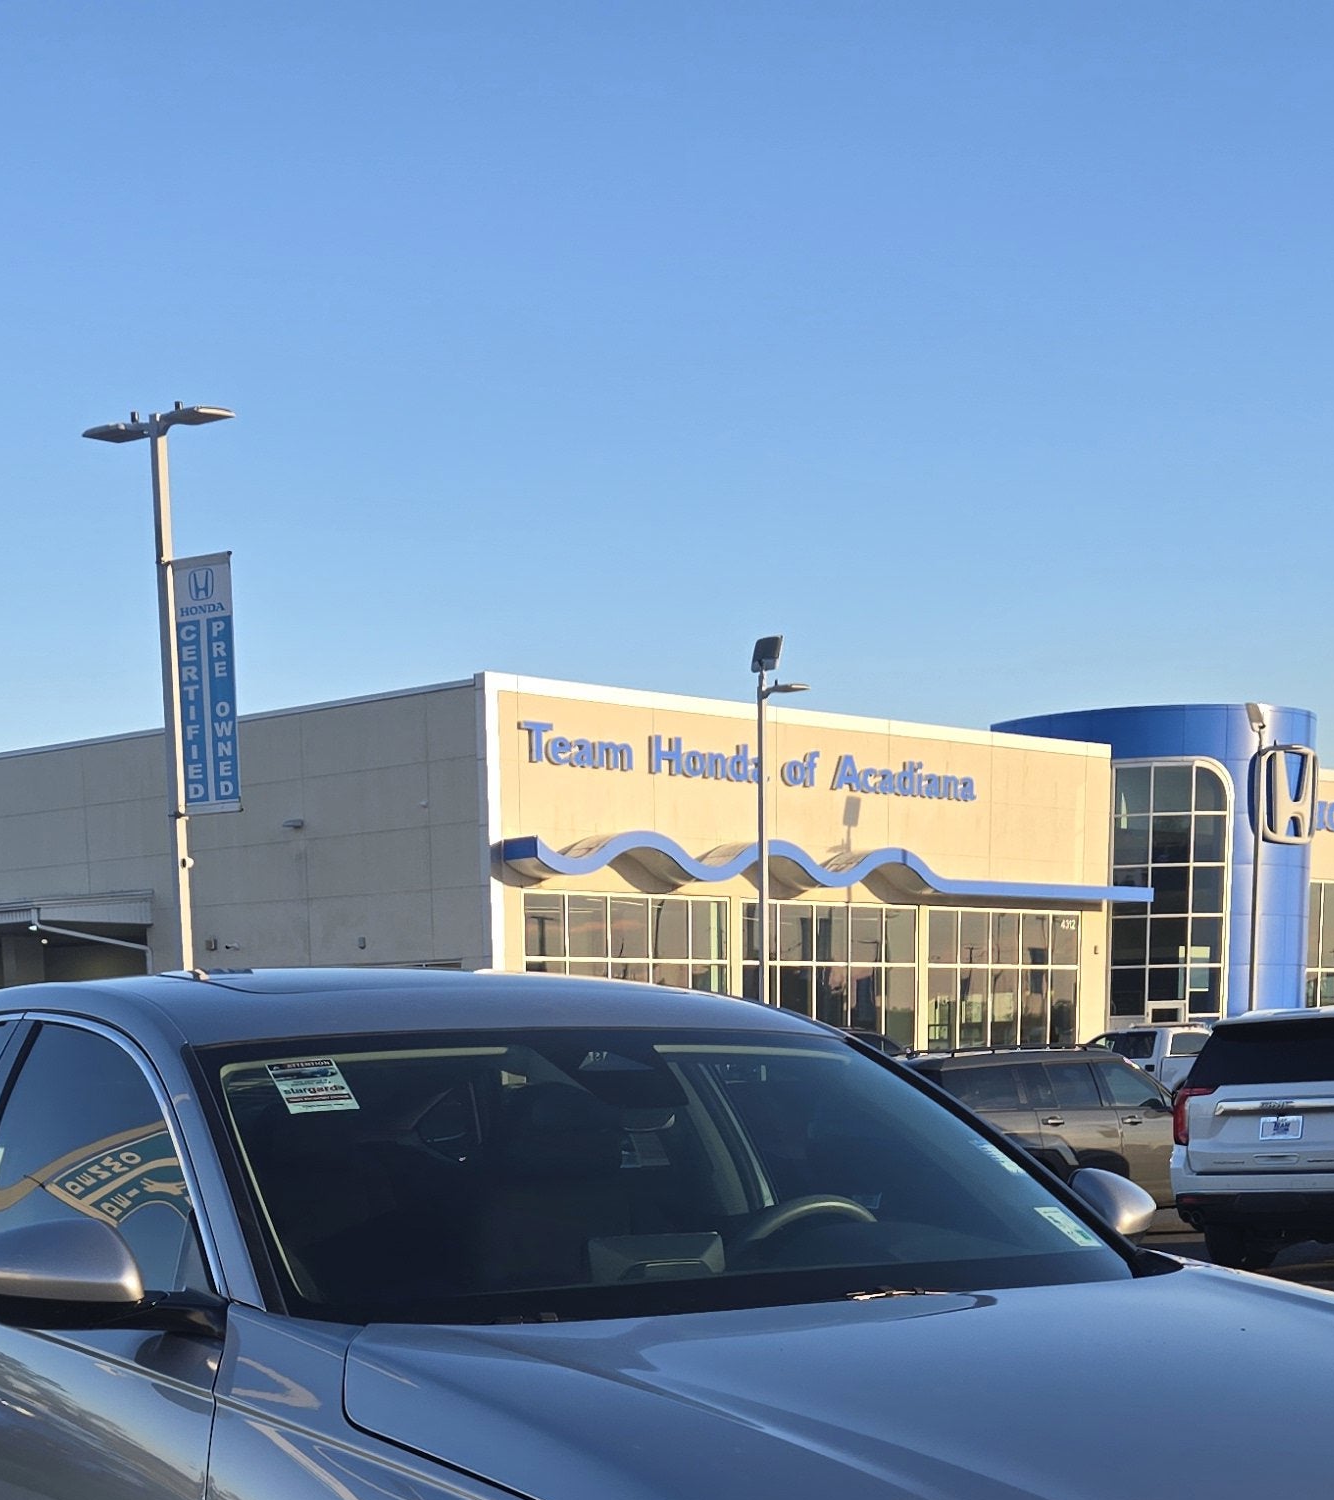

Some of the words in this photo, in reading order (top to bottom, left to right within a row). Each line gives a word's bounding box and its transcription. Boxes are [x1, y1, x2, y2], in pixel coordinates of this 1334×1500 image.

[180, 602, 225, 617] HONDA
[212, 620, 228, 678] PRE
[180, 625, 205, 799] CERTIFIED
[213, 701, 234, 796] OWNED
[519, 720, 633, 771] Team
[781, 751, 820, 787] of
[830, 754, 976, 802] Acadiana
[1060, 919, 1076, 930] 4312
